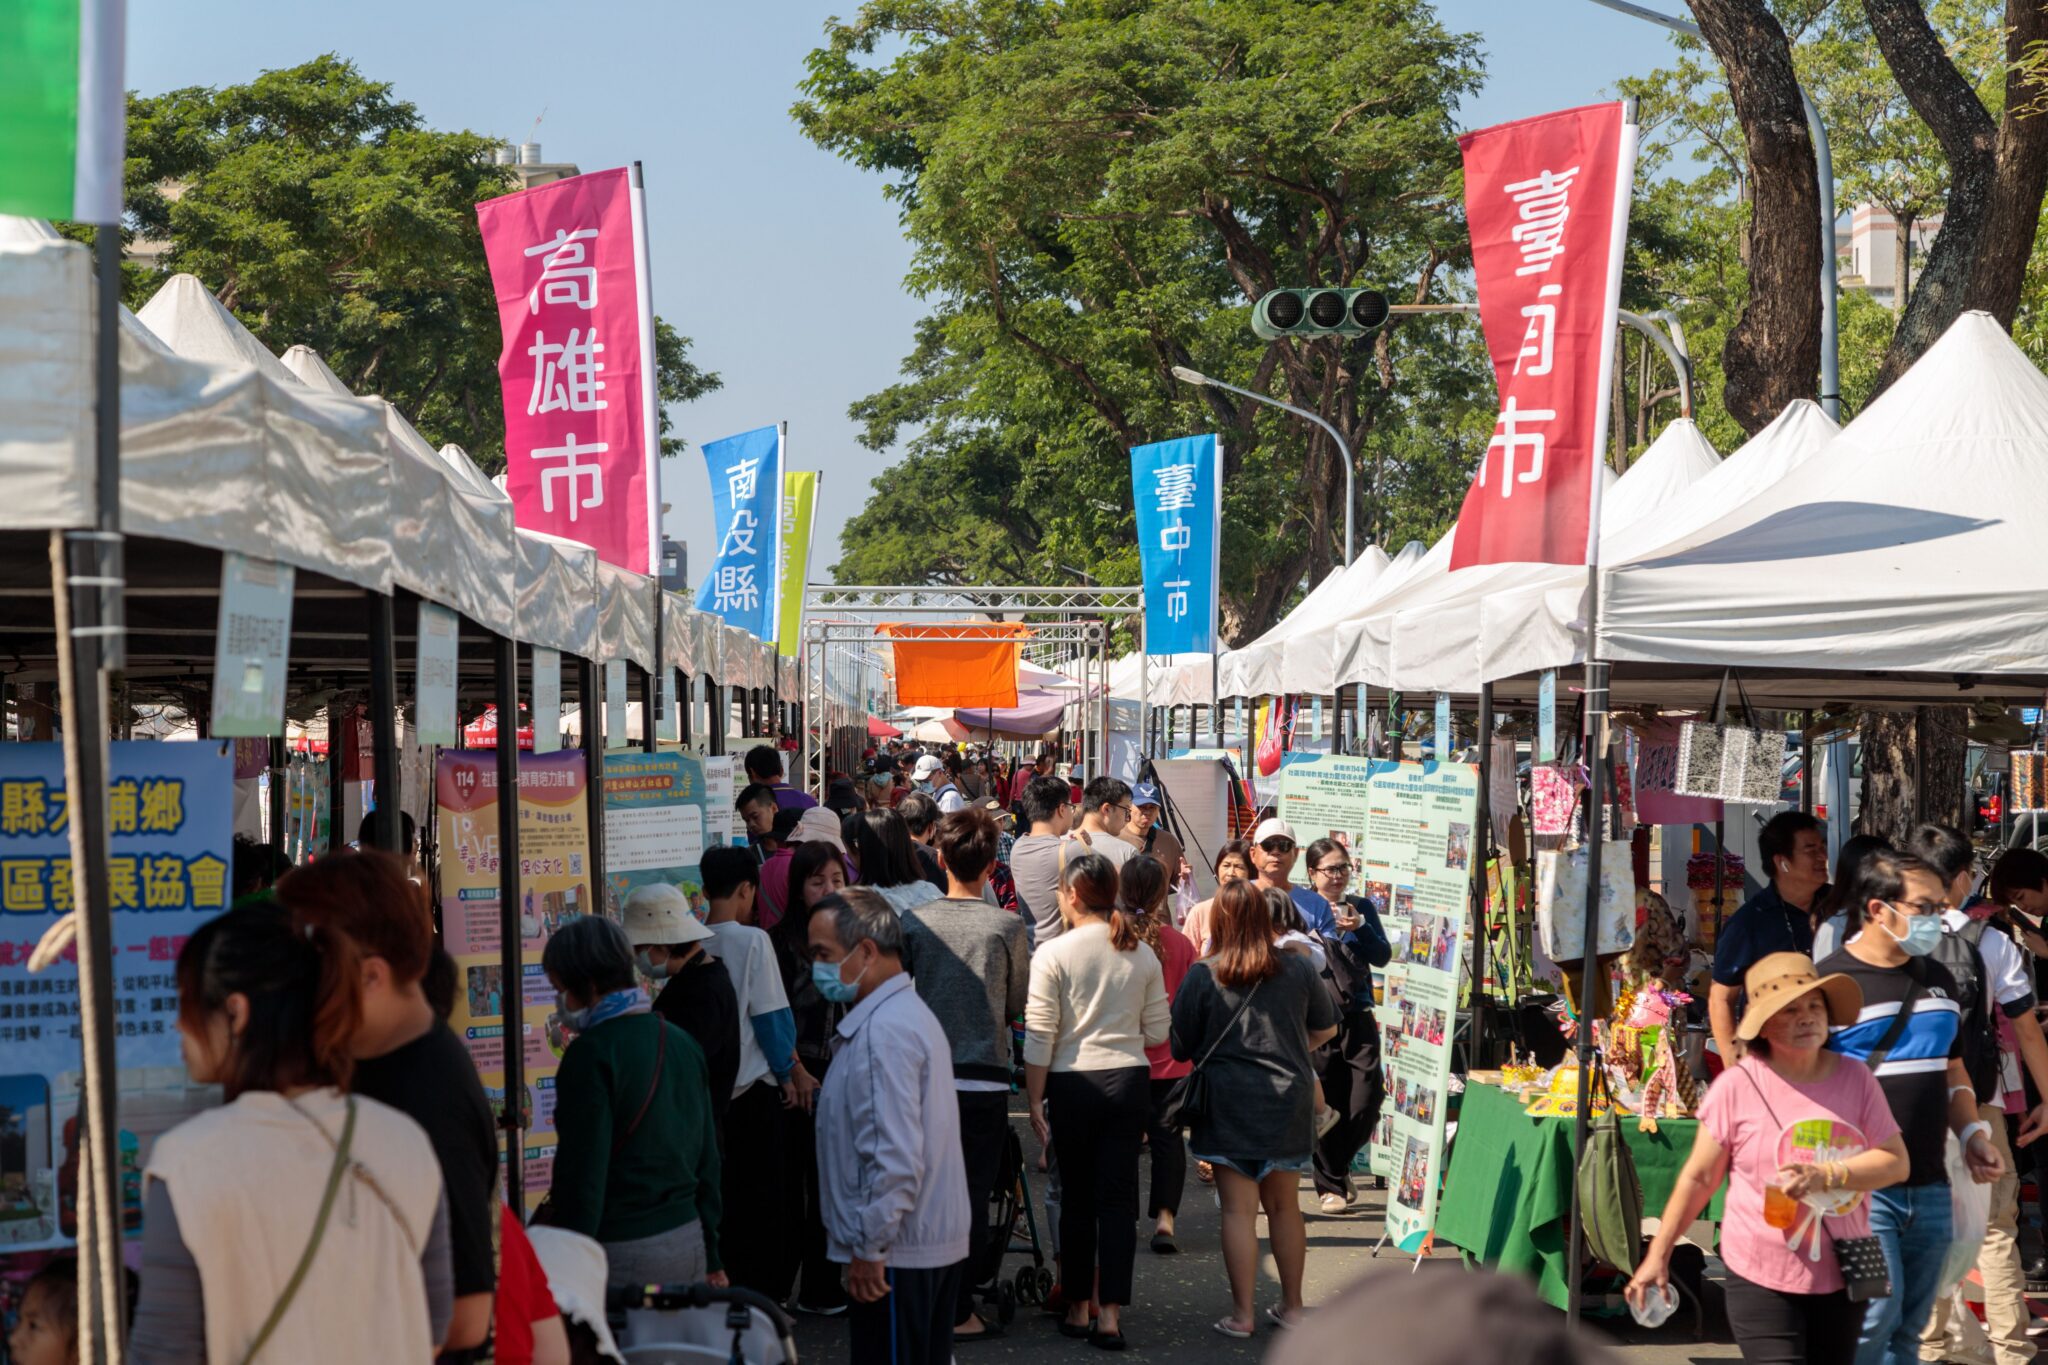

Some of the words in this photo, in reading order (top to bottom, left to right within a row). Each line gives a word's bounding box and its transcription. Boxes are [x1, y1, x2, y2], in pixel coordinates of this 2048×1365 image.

[524, 228, 608, 522] 高雄市
[713, 457, 759, 613] 南投縣
[1152, 464, 1197, 623] 臺中市
[456, 771, 474, 787] 114
[481, 769, 576, 788] 社區教育培力計畫
